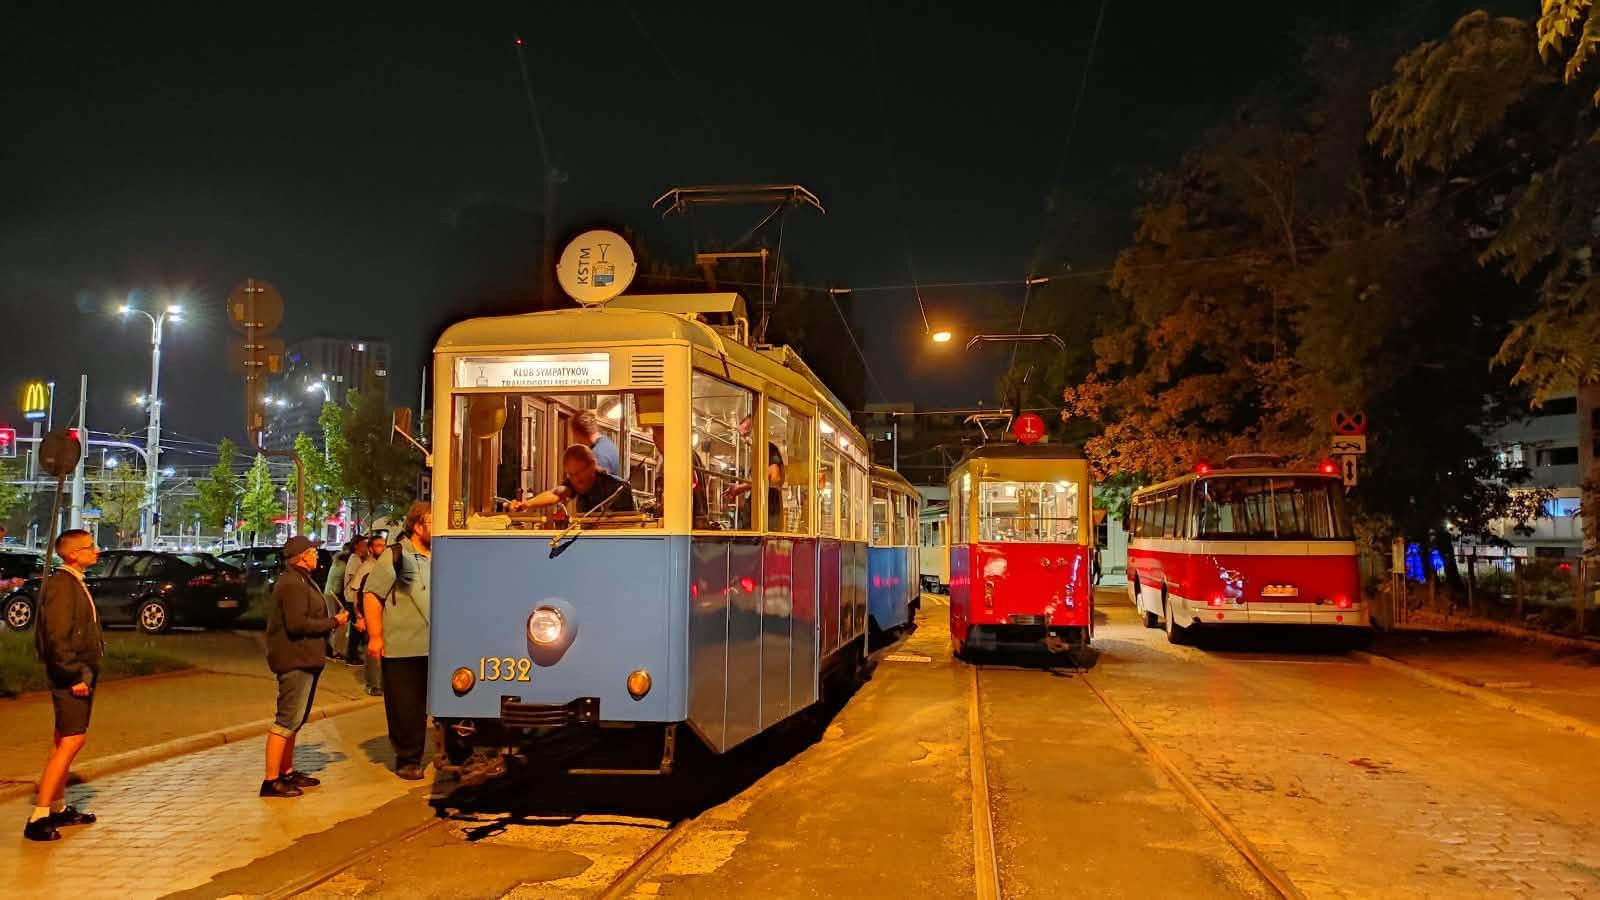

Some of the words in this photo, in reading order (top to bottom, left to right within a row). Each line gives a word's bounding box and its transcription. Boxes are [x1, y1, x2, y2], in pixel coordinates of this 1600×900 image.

[577, 248, 591, 285] KSTM
[513, 367, 534, 377] KLUB
[479, 656, 532, 682] 1332
